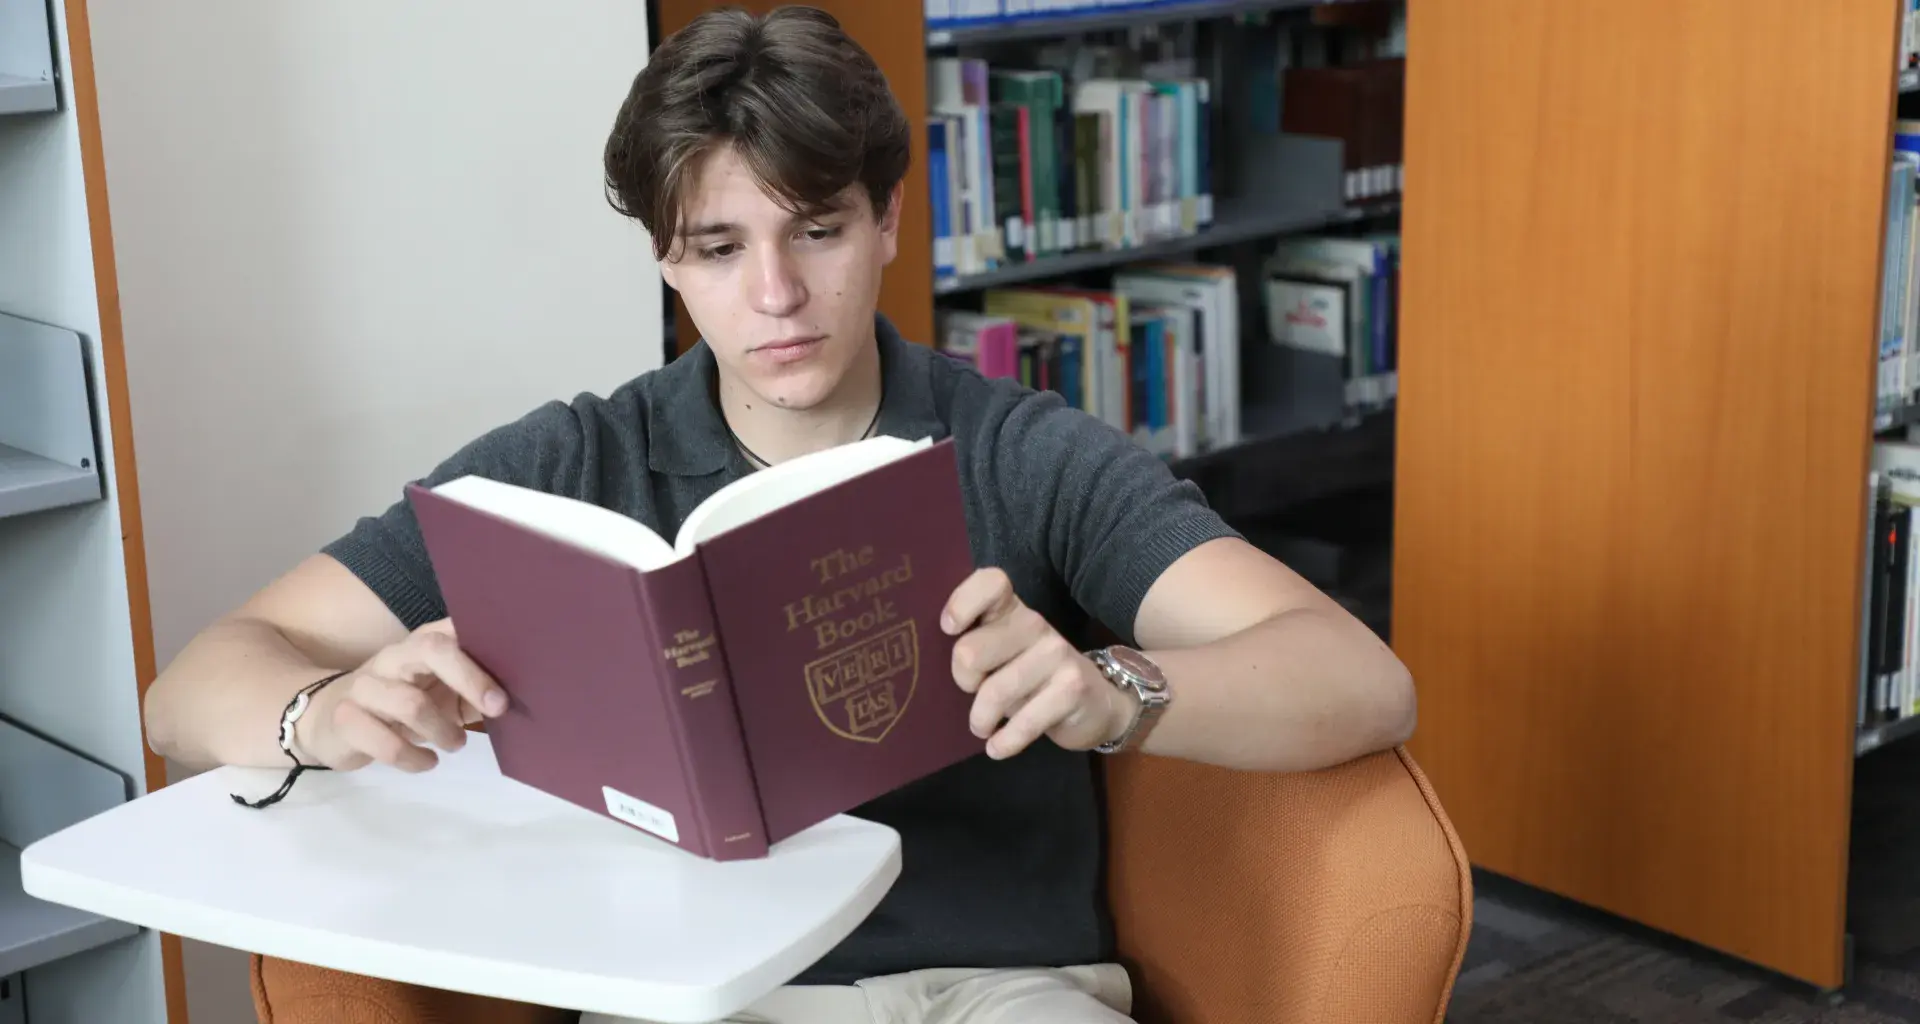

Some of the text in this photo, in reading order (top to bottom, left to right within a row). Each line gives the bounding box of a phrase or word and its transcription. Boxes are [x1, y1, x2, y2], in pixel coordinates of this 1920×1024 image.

[812, 545, 874, 584] The
[784, 554, 913, 632] Harvard
[814, 597, 898, 650] Book
